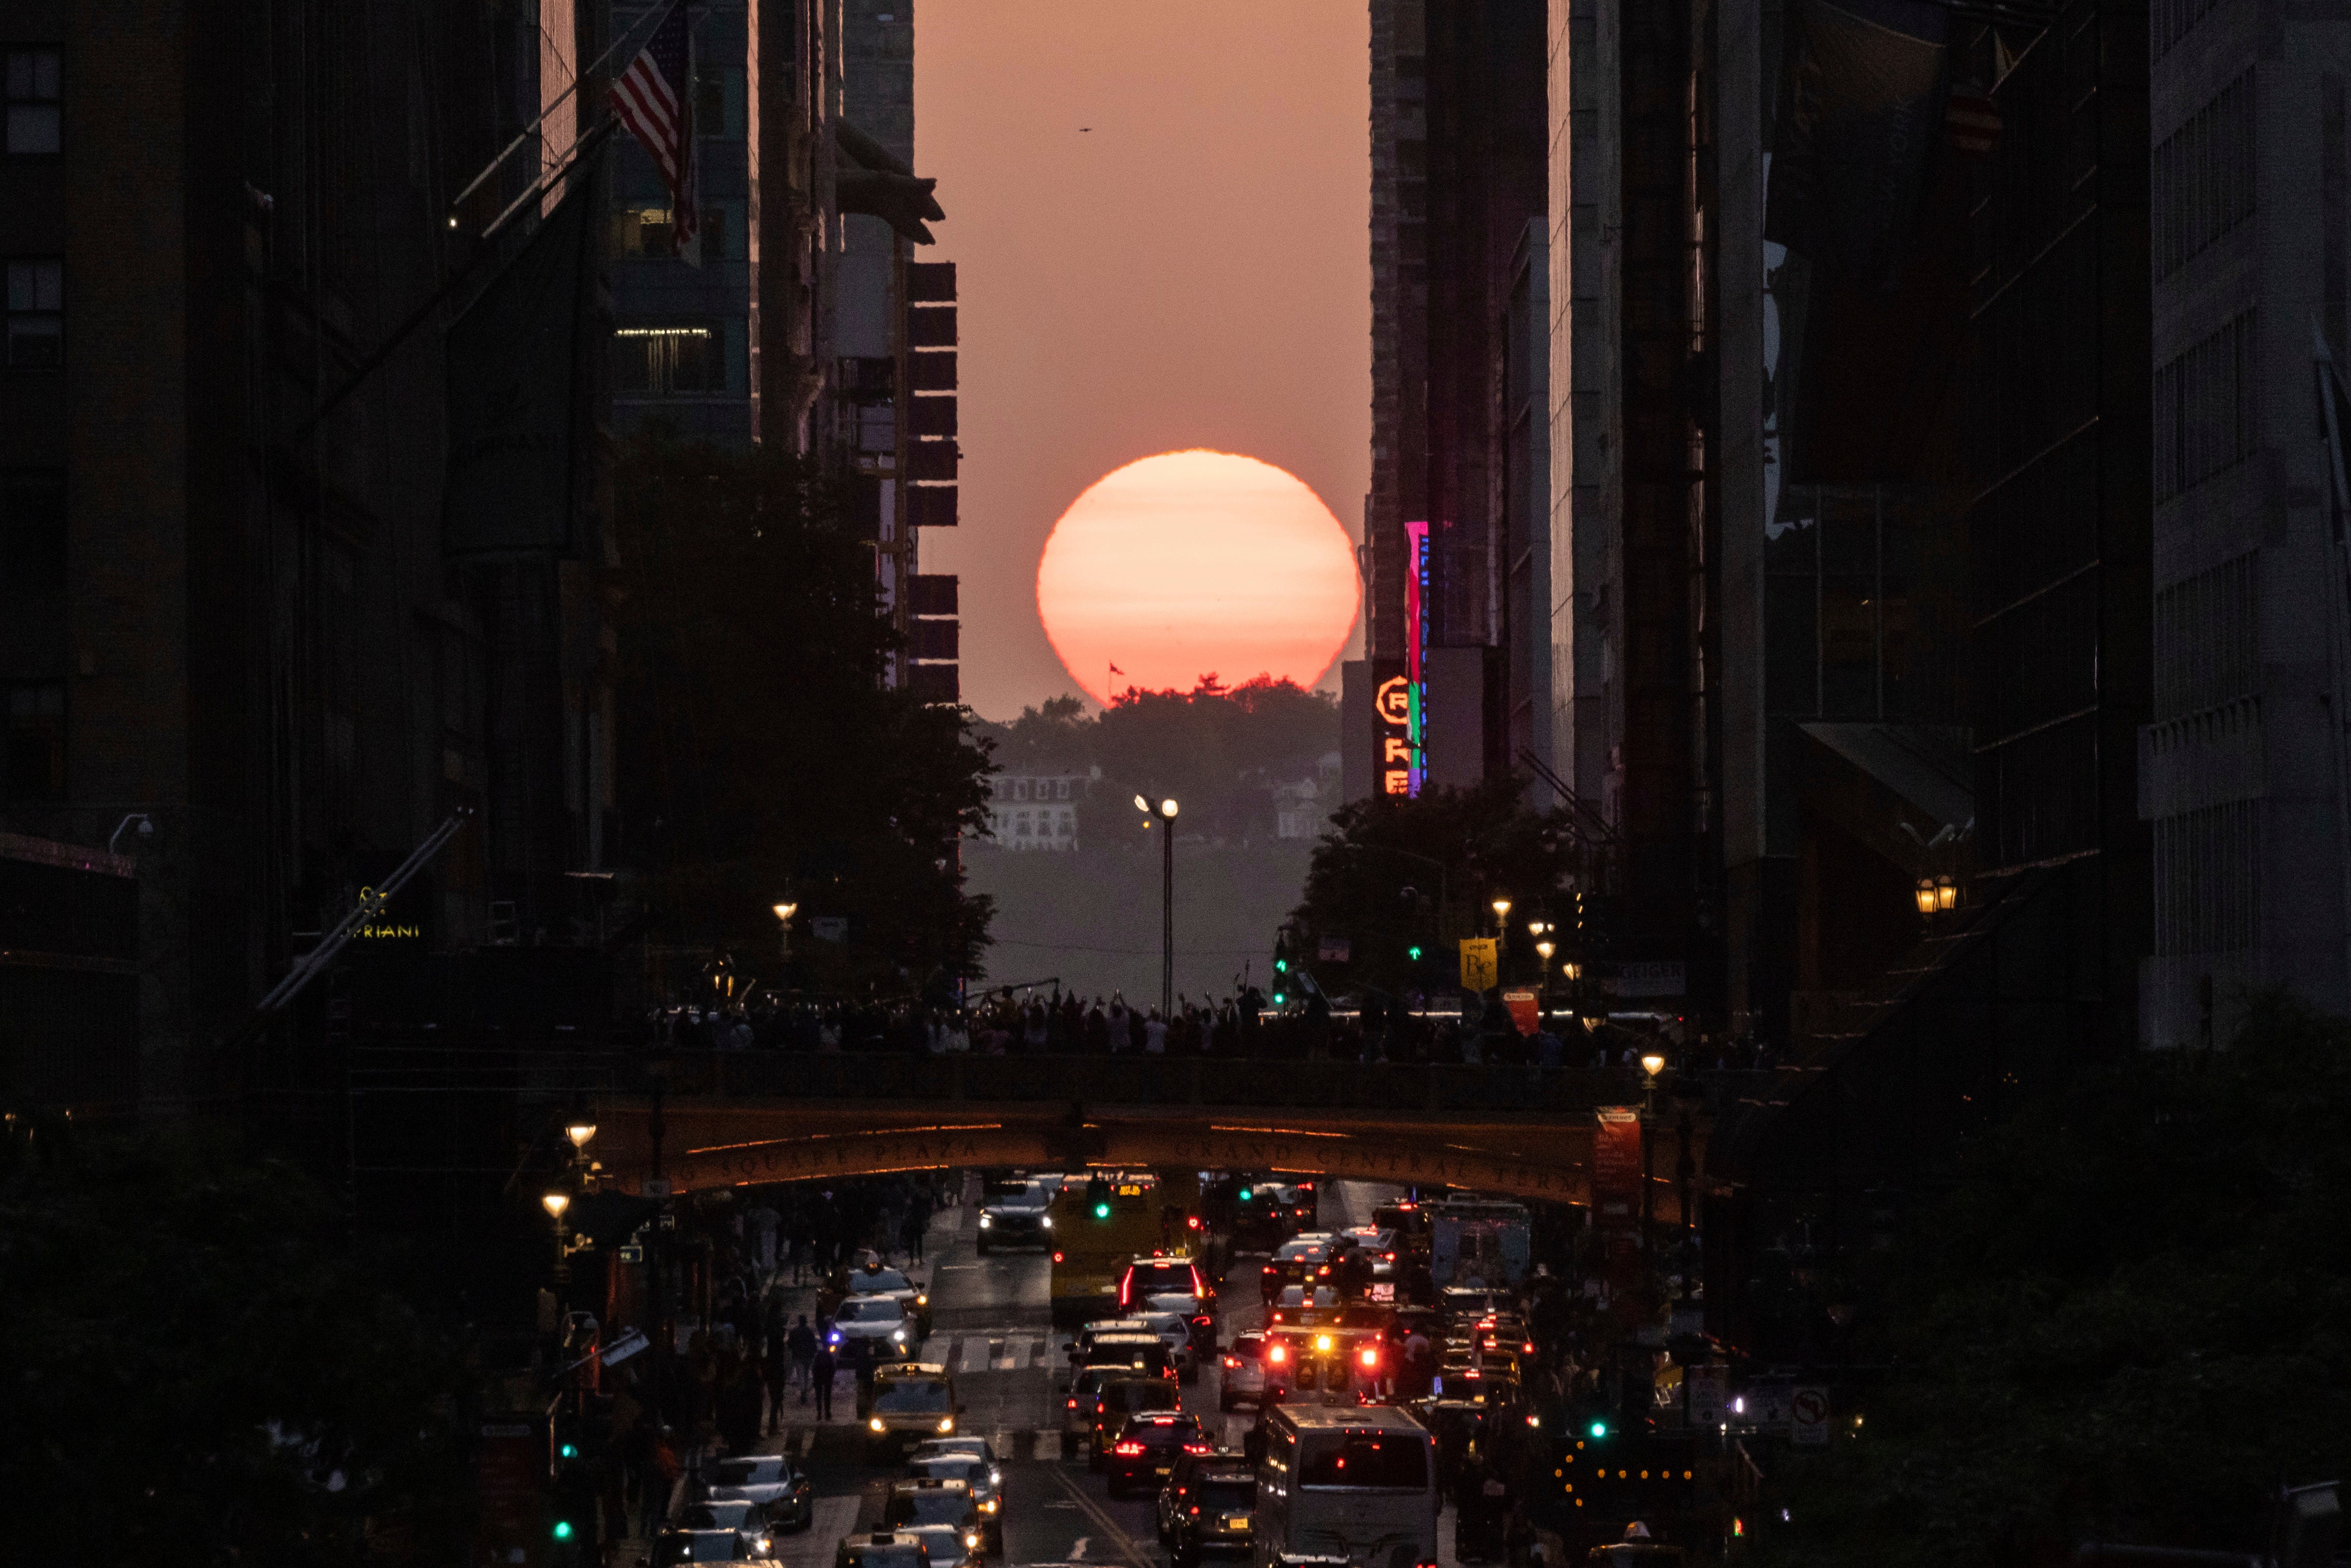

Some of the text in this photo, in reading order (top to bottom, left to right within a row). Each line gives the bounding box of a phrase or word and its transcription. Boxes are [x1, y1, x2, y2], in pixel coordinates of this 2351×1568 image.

[1385, 738, 1409, 795] RE
[339, 924, 420, 938] RIANI
[874, 1139, 977, 1162] PLAZA
[1176, 1141, 1578, 1194] GRAND CENTRAL TERM
